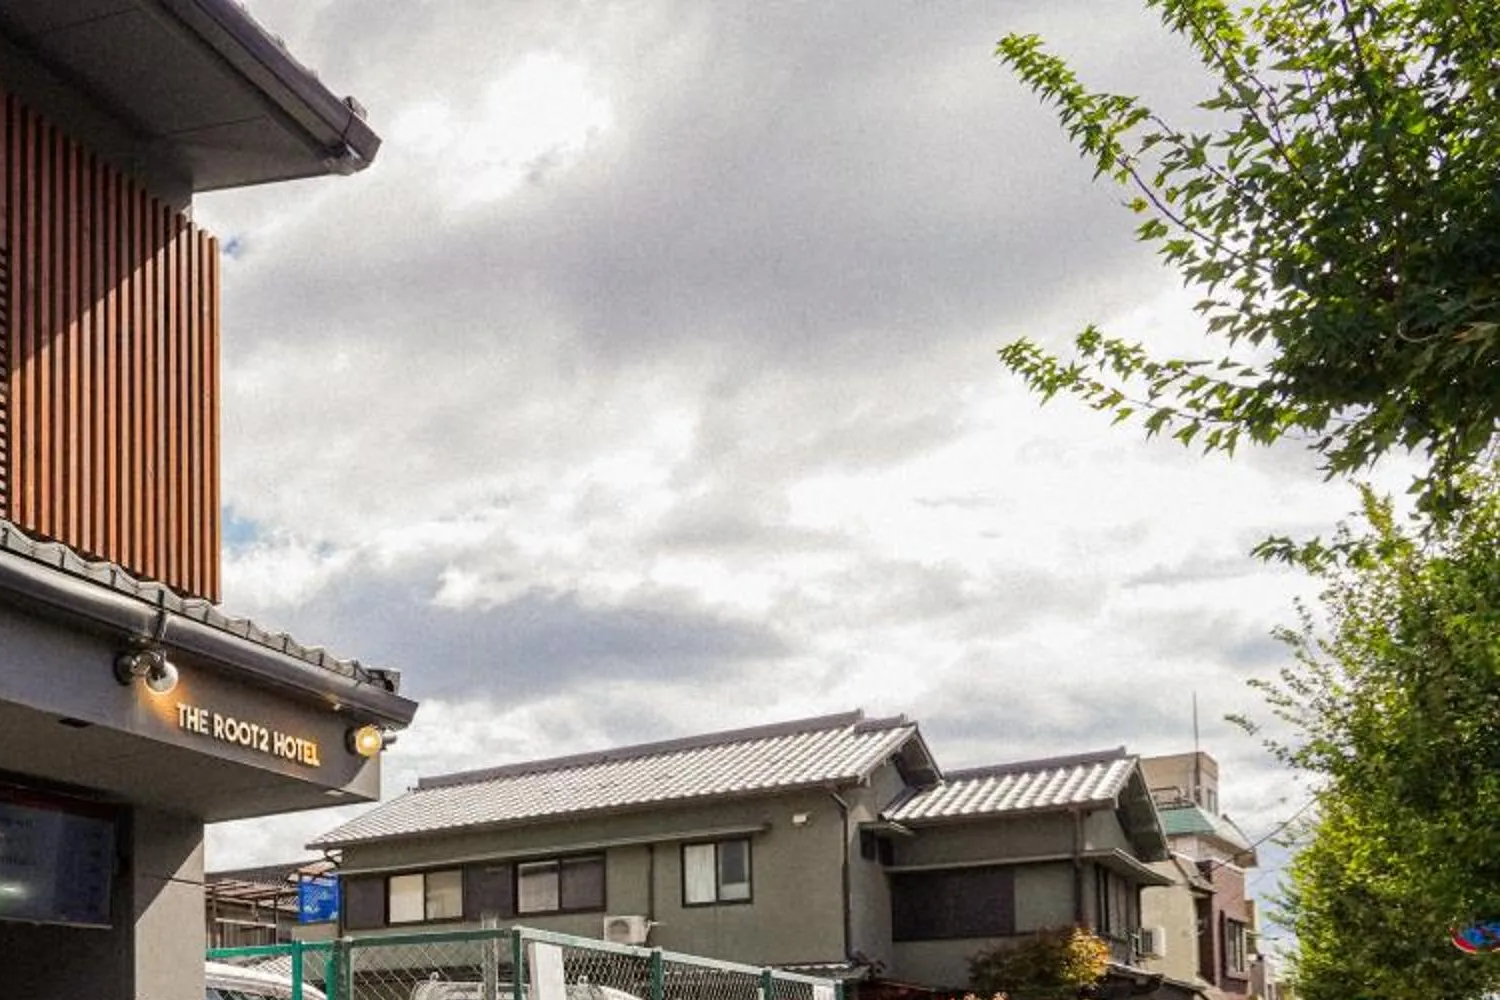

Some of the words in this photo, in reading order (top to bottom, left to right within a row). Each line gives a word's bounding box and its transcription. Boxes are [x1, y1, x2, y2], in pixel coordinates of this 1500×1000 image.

[177, 702, 209, 735] THE
[213, 713, 269, 752] ROOT2
[273, 731, 321, 767] HOTEL
